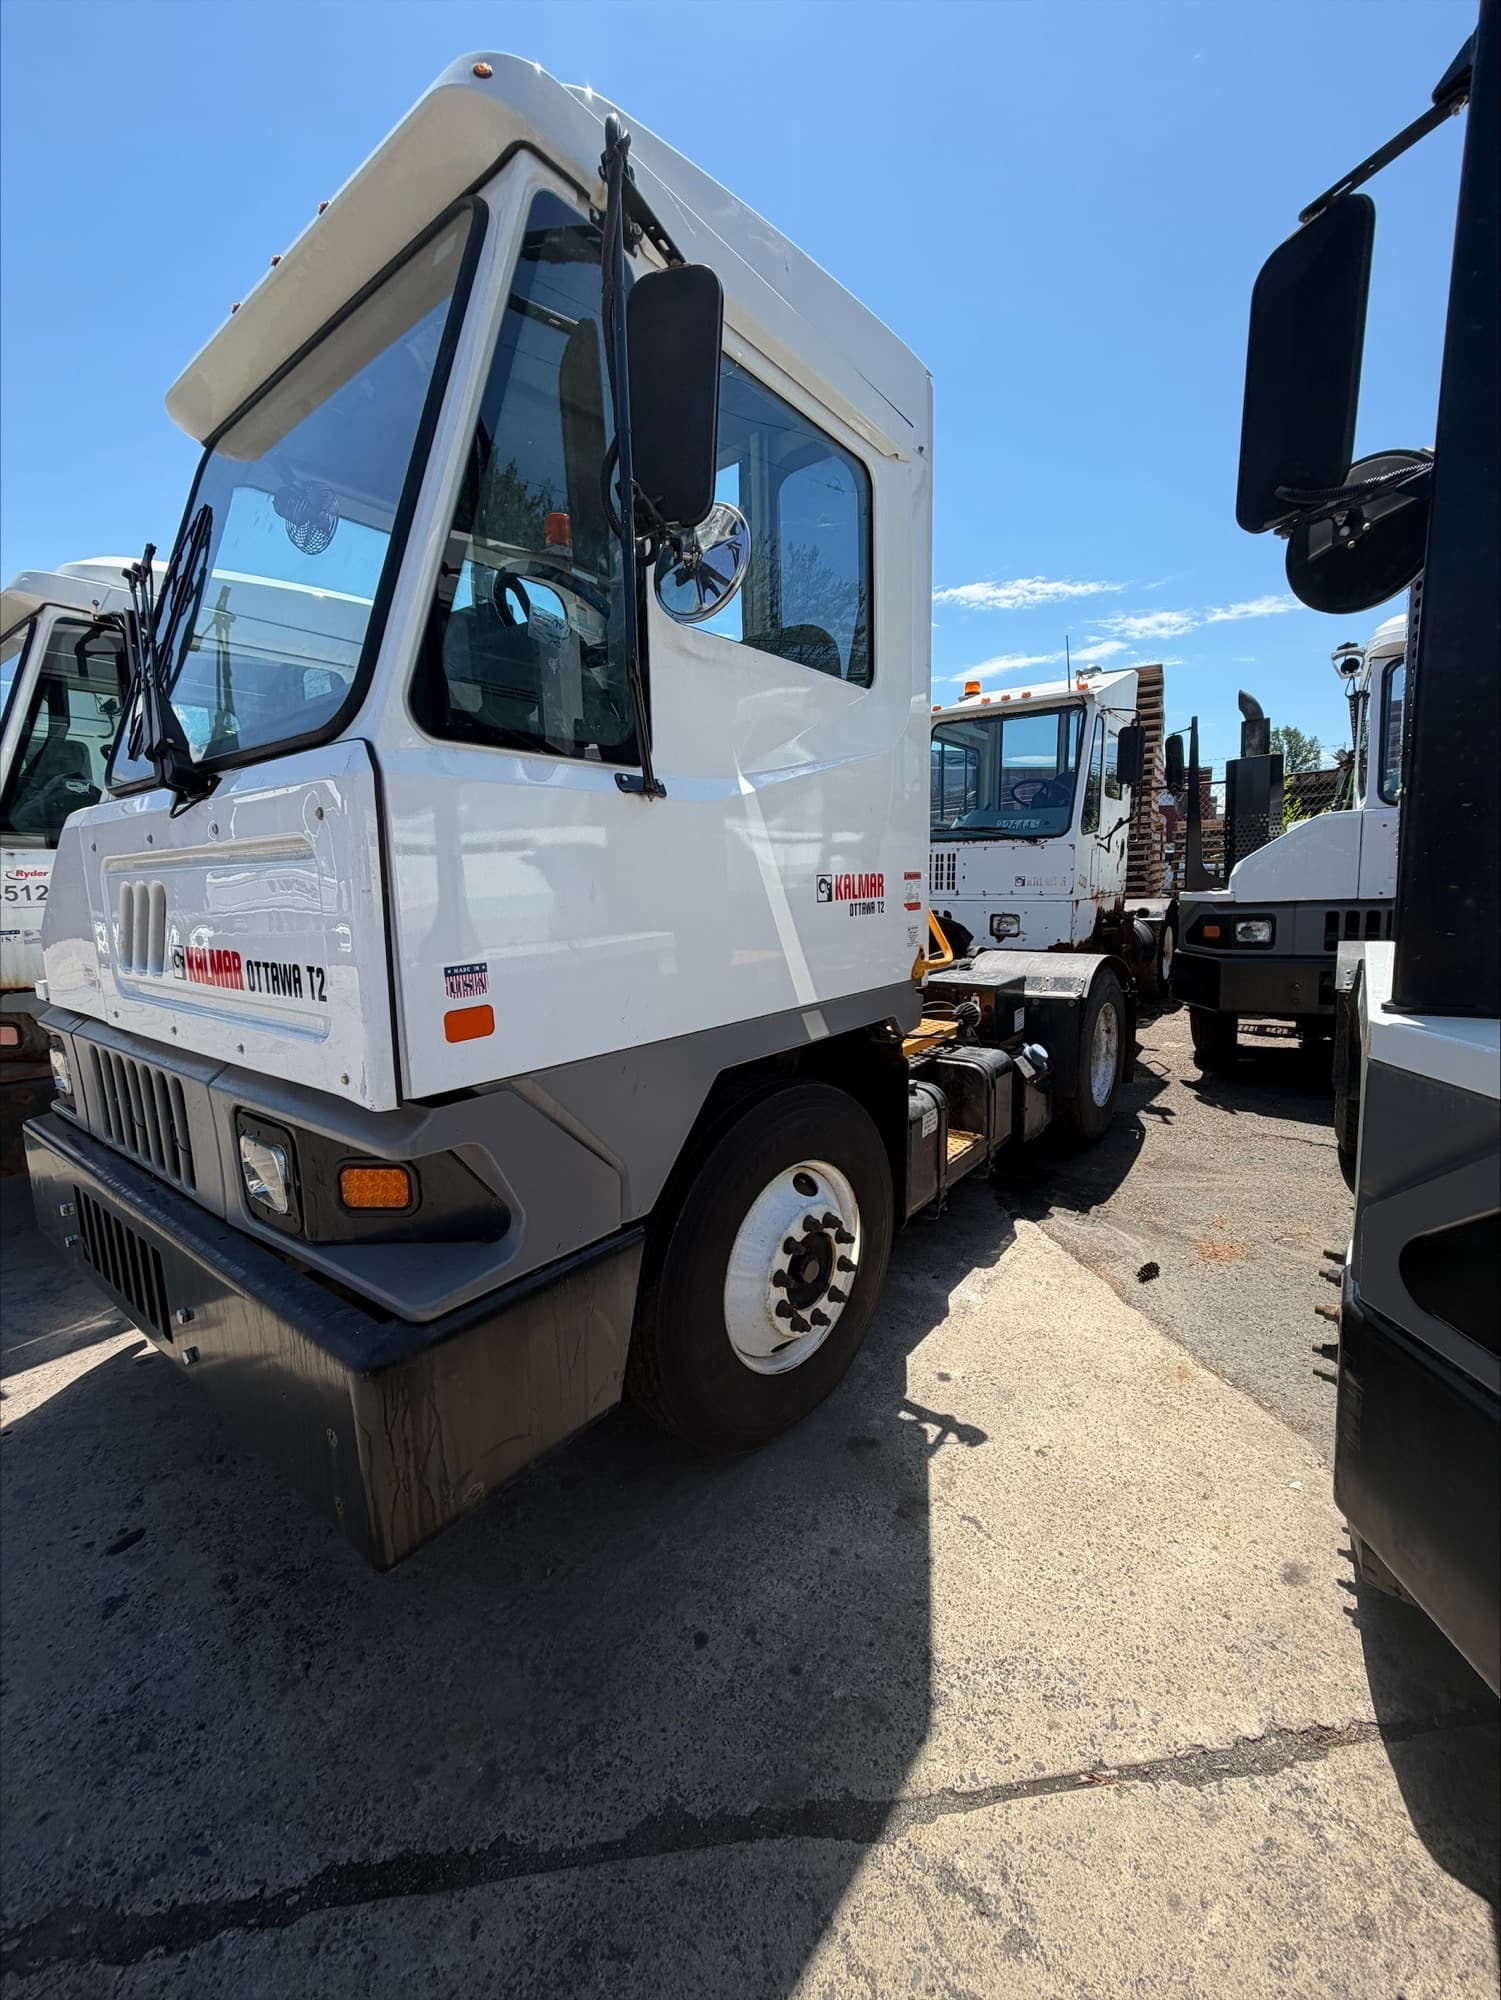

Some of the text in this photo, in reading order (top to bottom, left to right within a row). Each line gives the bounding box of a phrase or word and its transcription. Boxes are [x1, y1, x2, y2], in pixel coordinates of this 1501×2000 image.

[15, 870, 49, 879] Ryder
[0, 885, 49, 901] 512
[835, 873, 885, 901] KALMAR
[849, 901, 885, 917] OTTAWA T2
[185, 946, 328, 1002] KALMAR OTTAWA T2
[449, 978, 487, 994] USA
